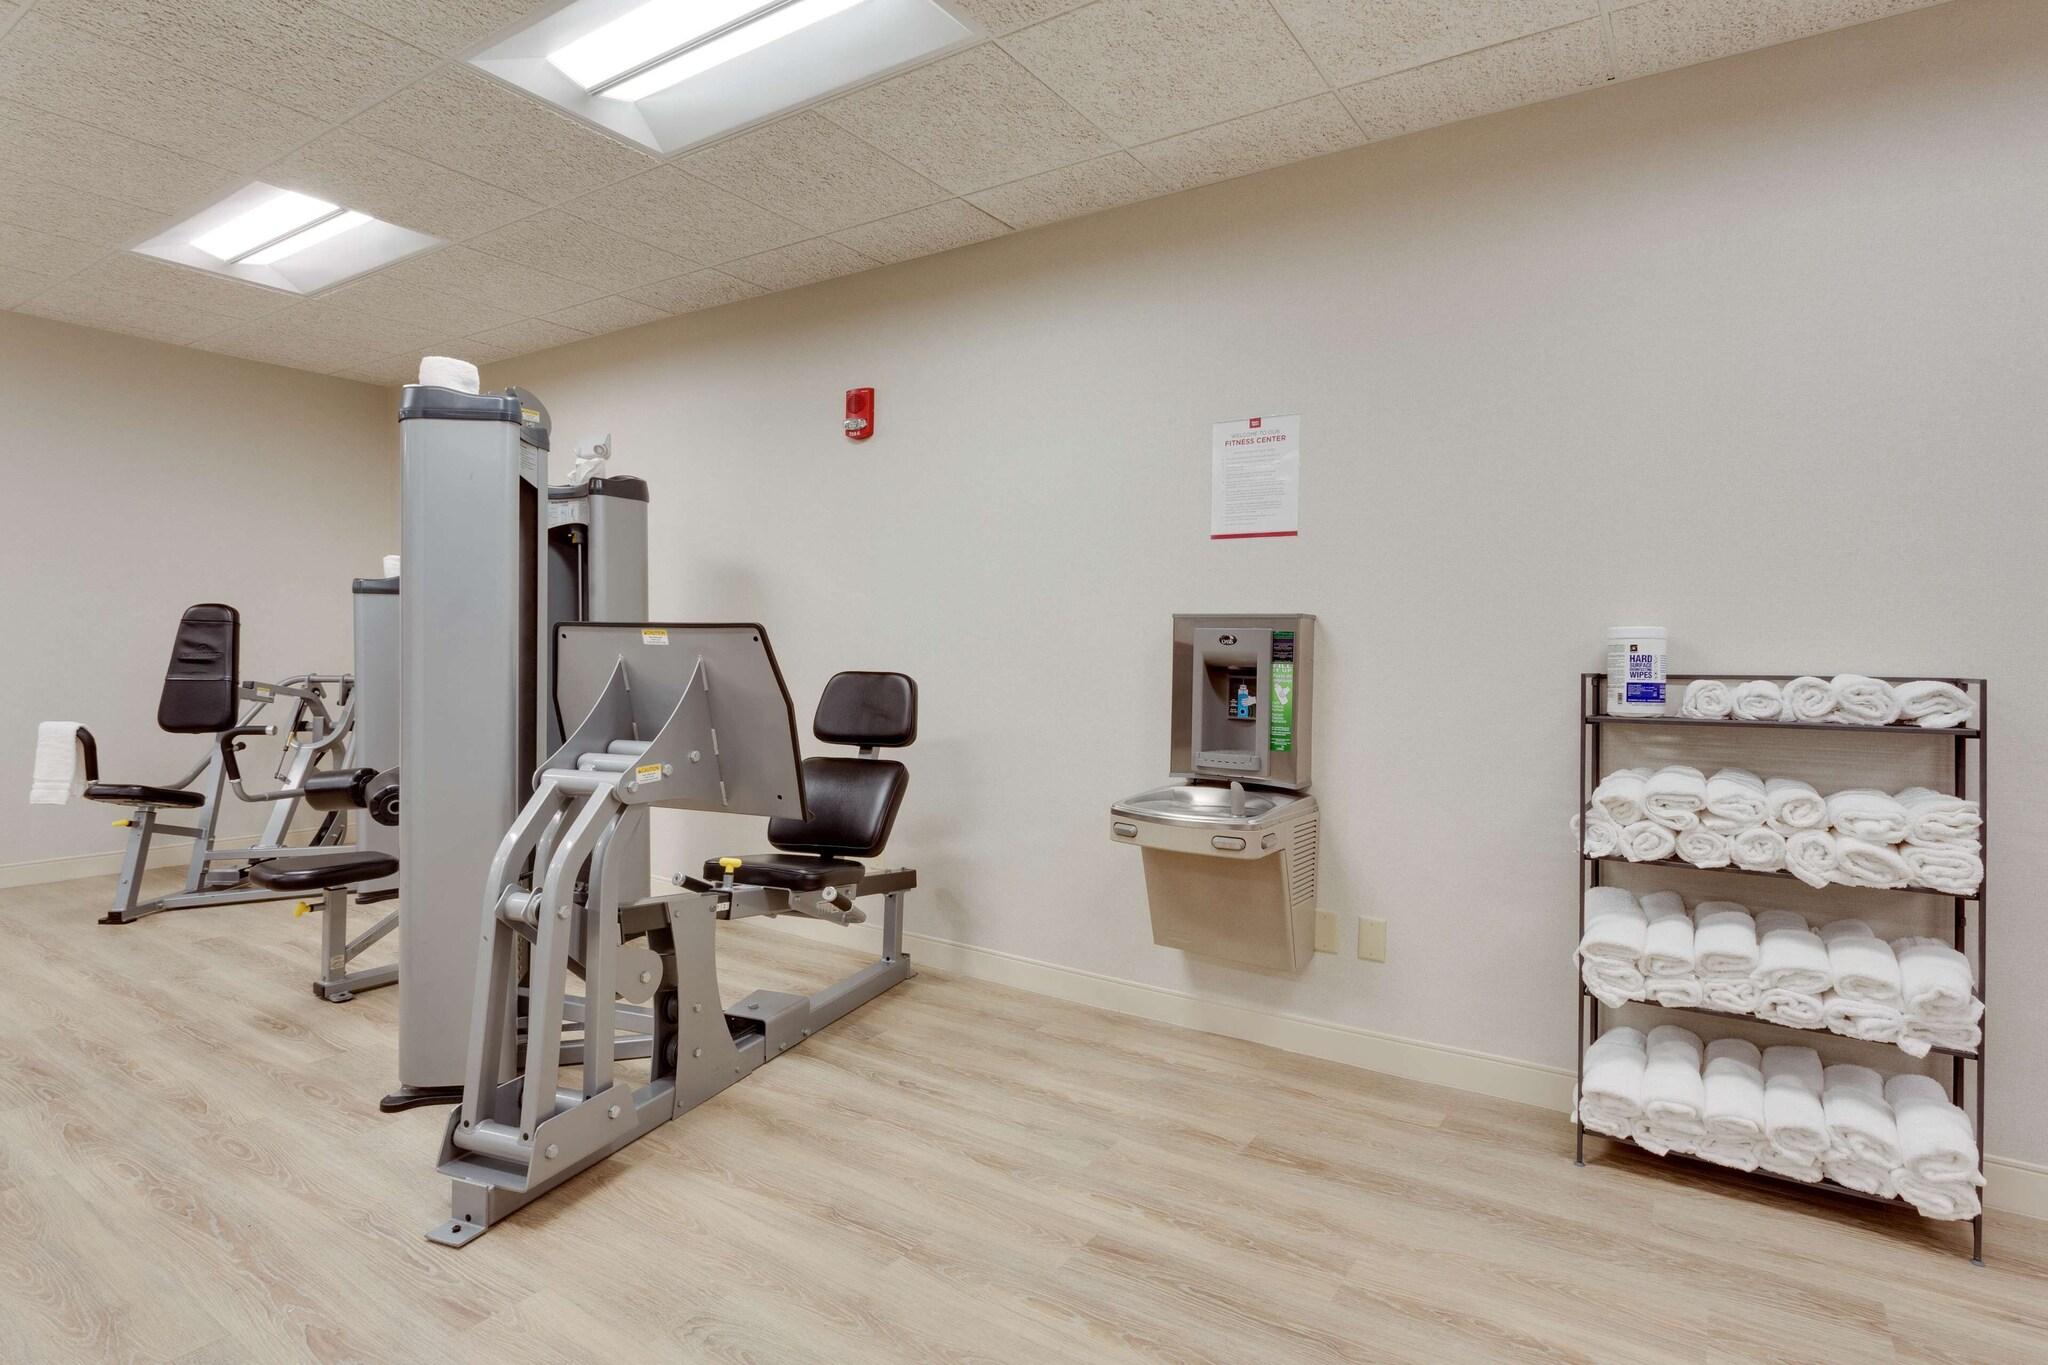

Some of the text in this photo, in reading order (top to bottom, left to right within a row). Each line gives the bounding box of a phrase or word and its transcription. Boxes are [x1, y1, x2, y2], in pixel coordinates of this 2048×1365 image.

[1231, 430, 1257, 438] WELCOME
[1224, 434, 1286, 447] FITNESS CENTER
[1629, 654, 1652, 662] HARD
